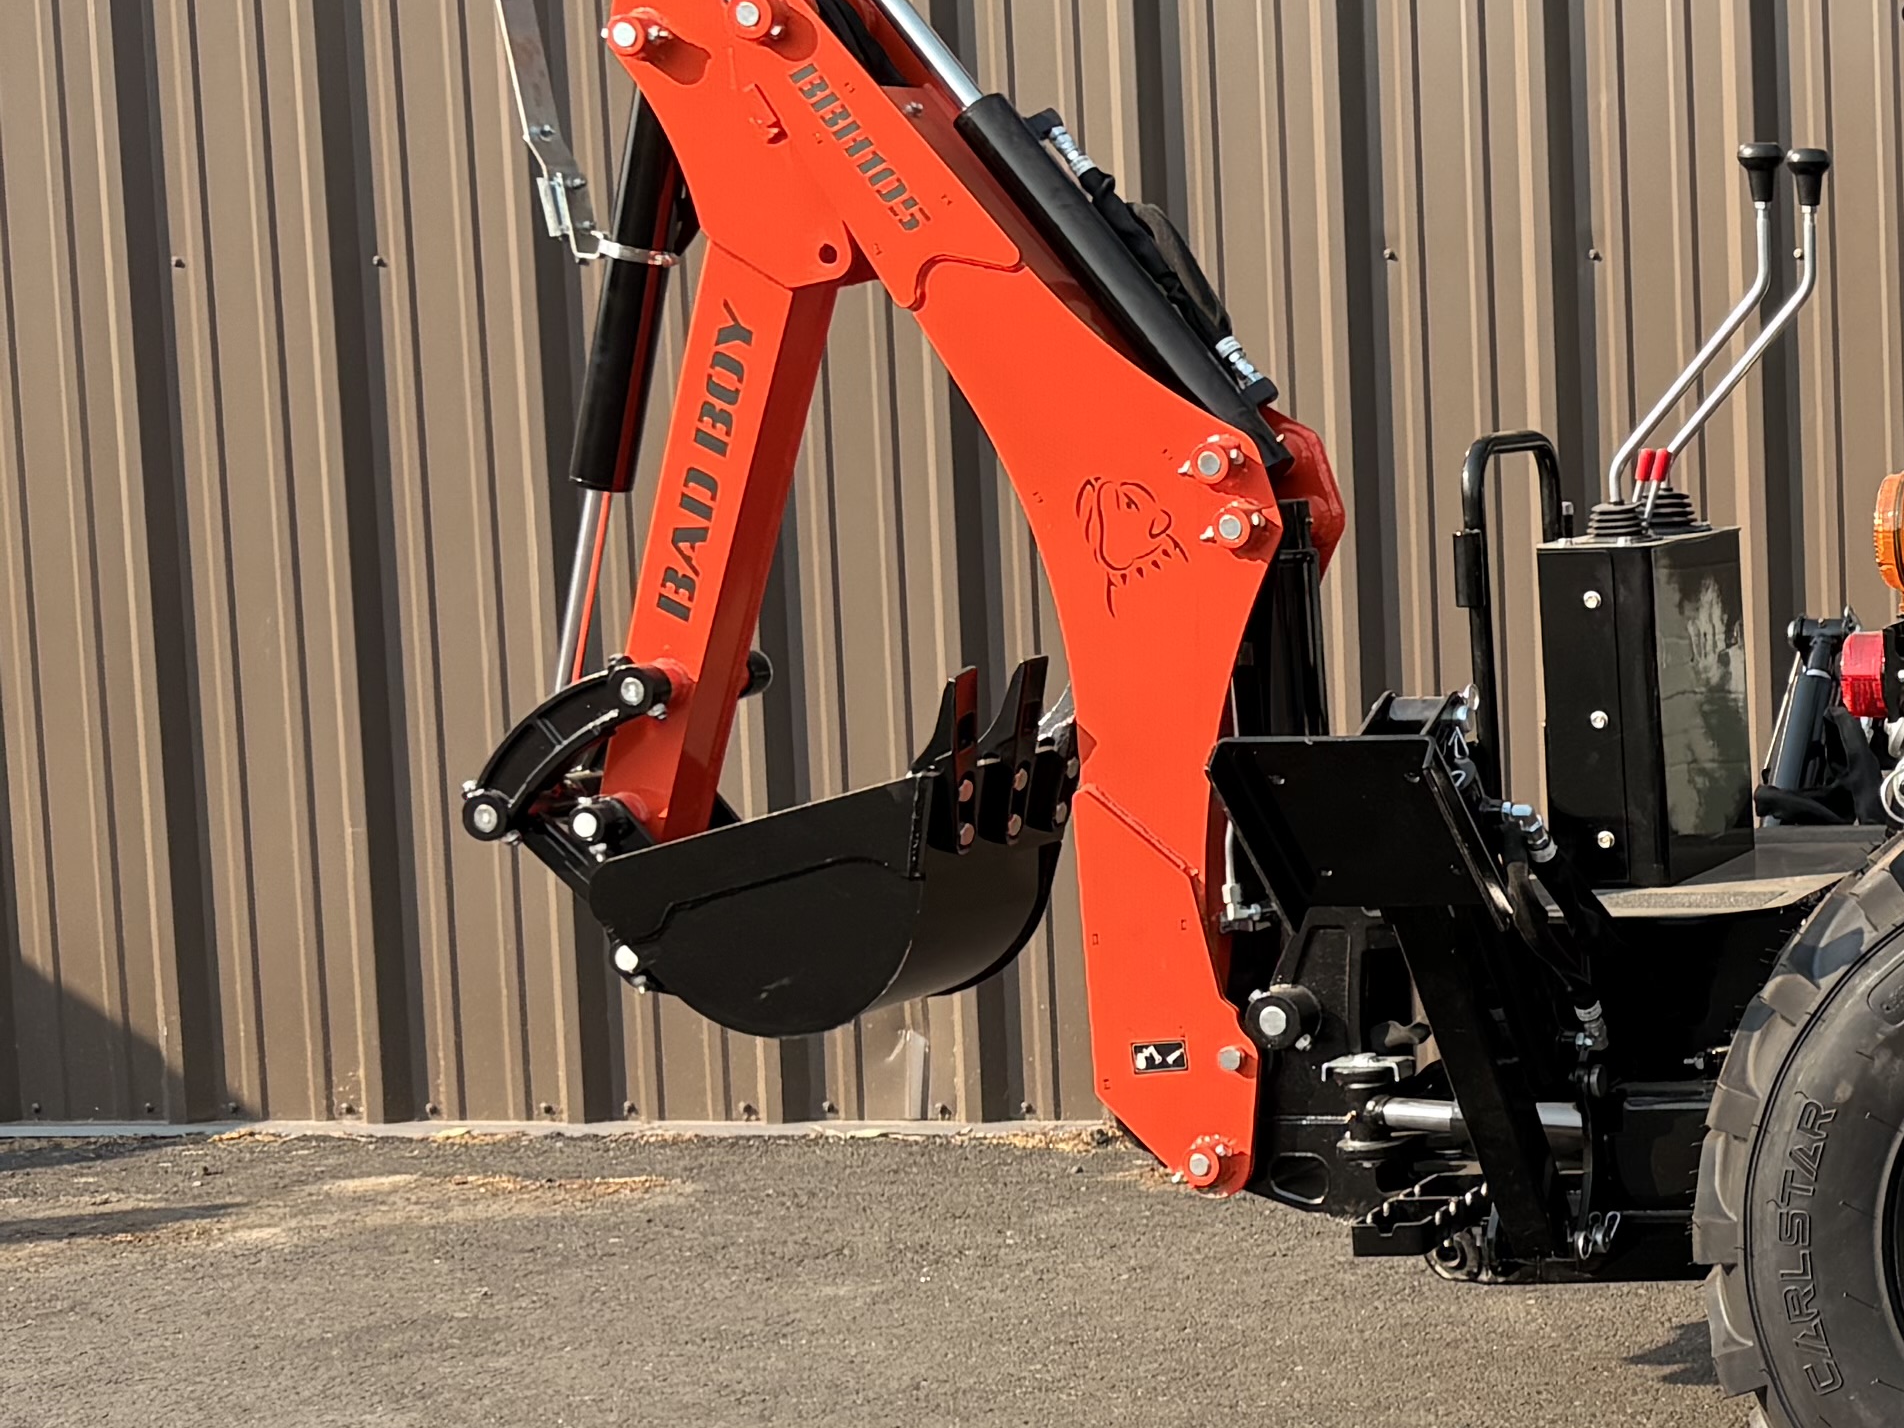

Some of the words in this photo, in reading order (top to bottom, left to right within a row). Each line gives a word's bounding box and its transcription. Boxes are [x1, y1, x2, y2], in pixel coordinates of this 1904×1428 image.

[657, 469, 720, 622] BAD
[695, 298, 757, 457] BOY
[1777, 1097, 1839, 1397] CARLSTAR
